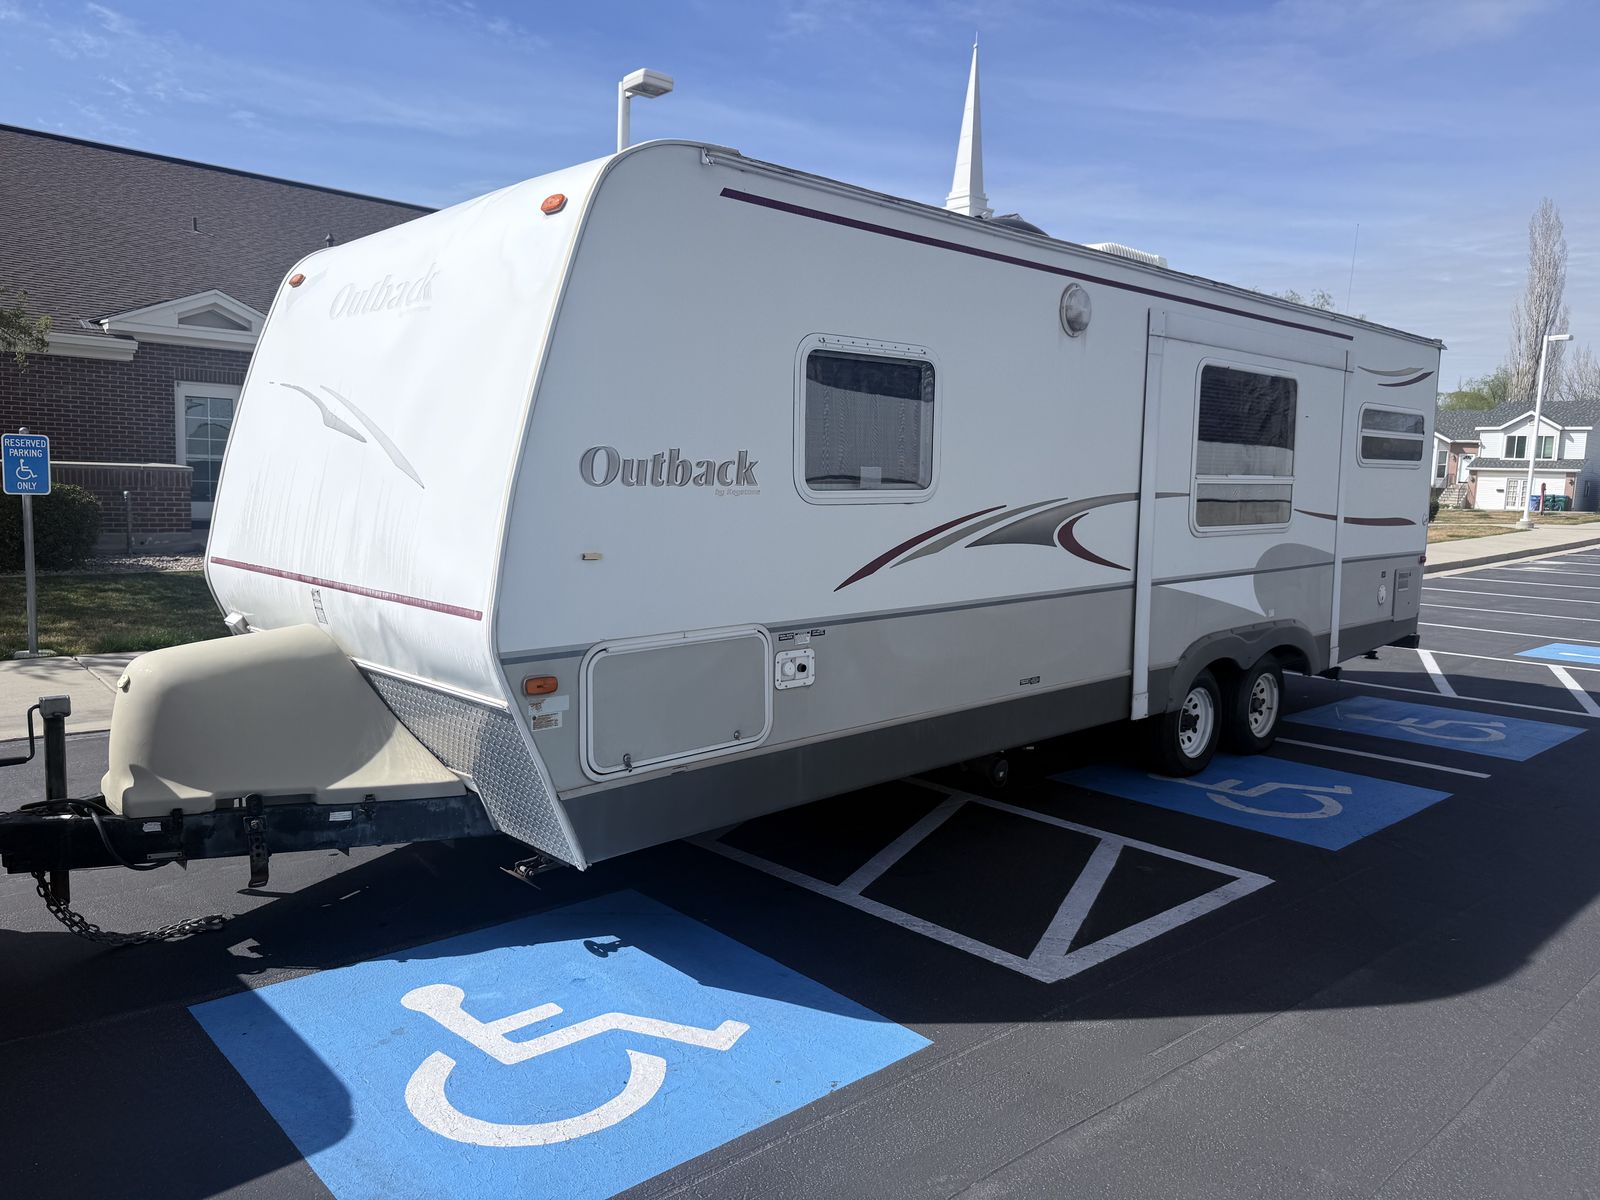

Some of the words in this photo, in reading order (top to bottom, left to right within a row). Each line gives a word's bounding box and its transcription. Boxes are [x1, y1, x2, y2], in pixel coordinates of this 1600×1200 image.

[329, 262, 440, 320] Outback
[4, 438, 46, 448] RESERVED
[9, 448, 42, 458] PARKING
[579, 445, 759, 487] Outback
[17, 482, 37, 490] ONLY
